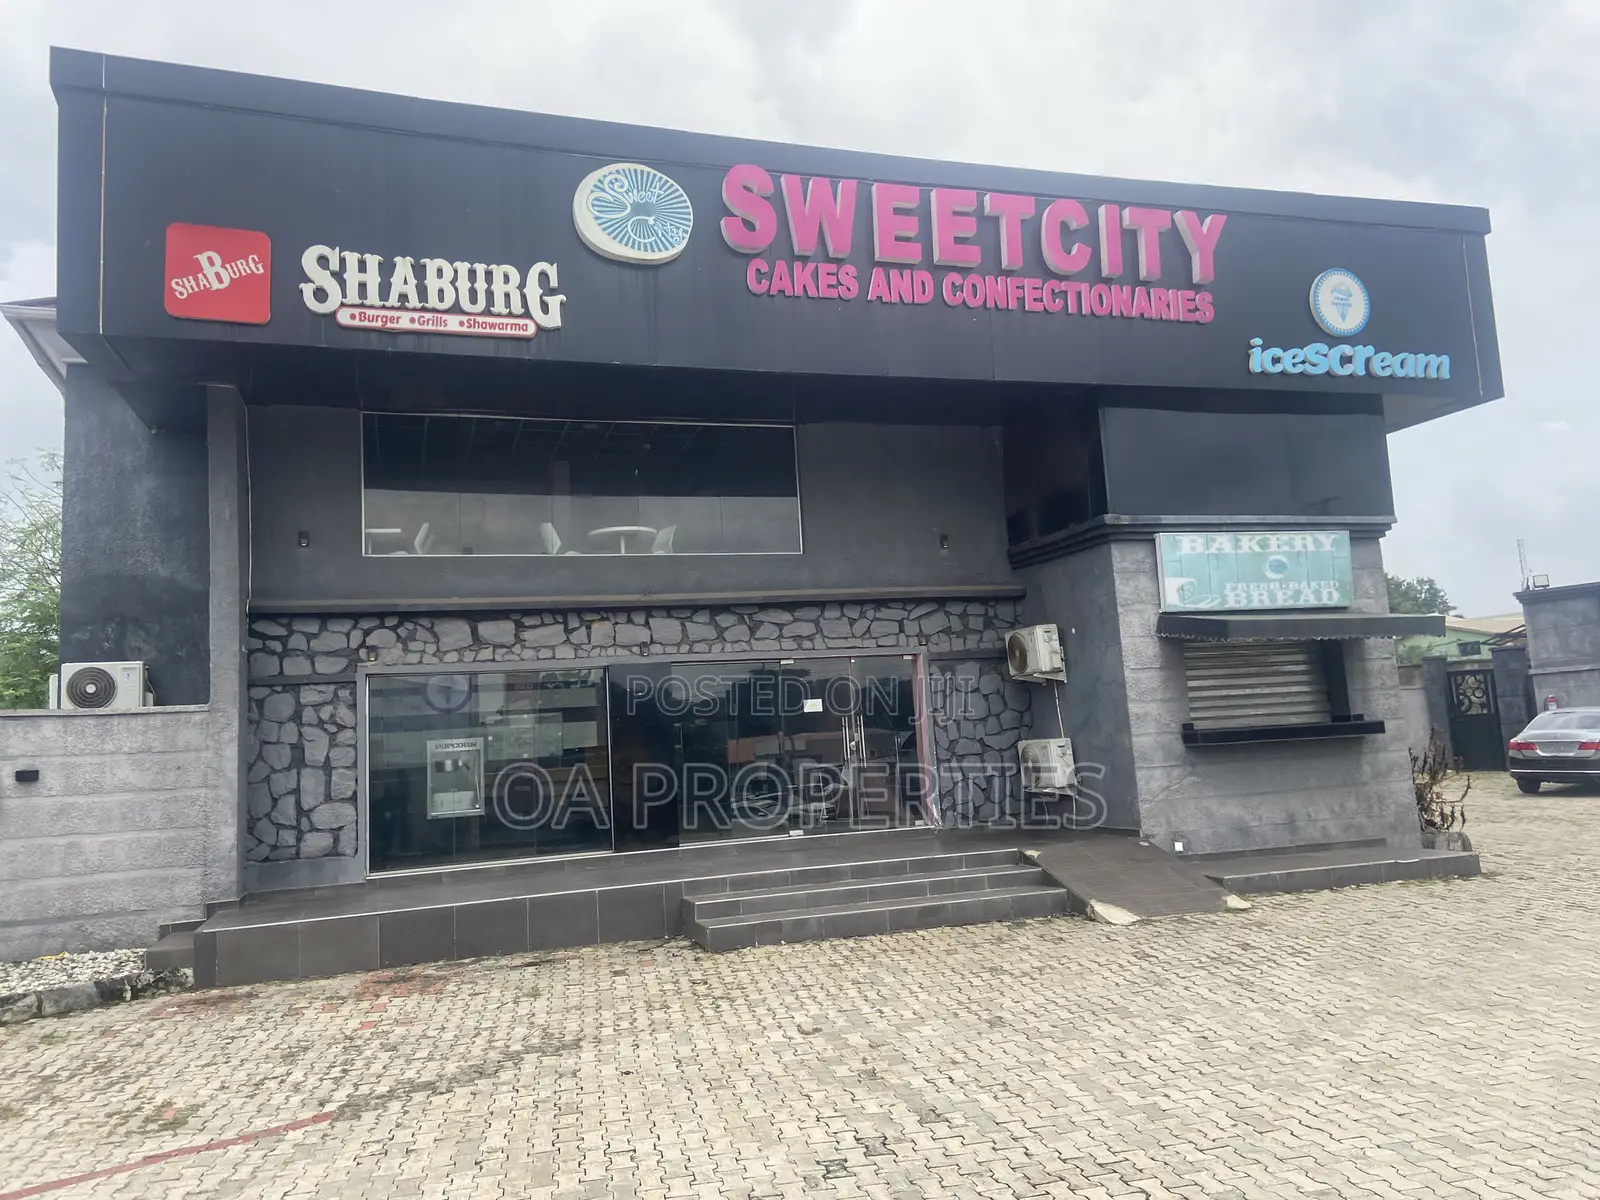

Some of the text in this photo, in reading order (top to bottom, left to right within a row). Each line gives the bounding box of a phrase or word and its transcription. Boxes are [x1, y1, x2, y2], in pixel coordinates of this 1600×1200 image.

[719, 164, 1227, 285] SWEETCITY
[170, 250, 265, 300] SHABURG
[298, 244, 567, 331] SHABURG
[746, 258, 1215, 323] CAKES AND CONFECTIONARIES
[358, 311, 529, 332] Burger Grills Shawarma
[1174, 533, 1340, 555] BAKERY
[1224, 580, 1339, 593] FRESH-BAKED
[1224, 588, 1341, 608] BREAD
